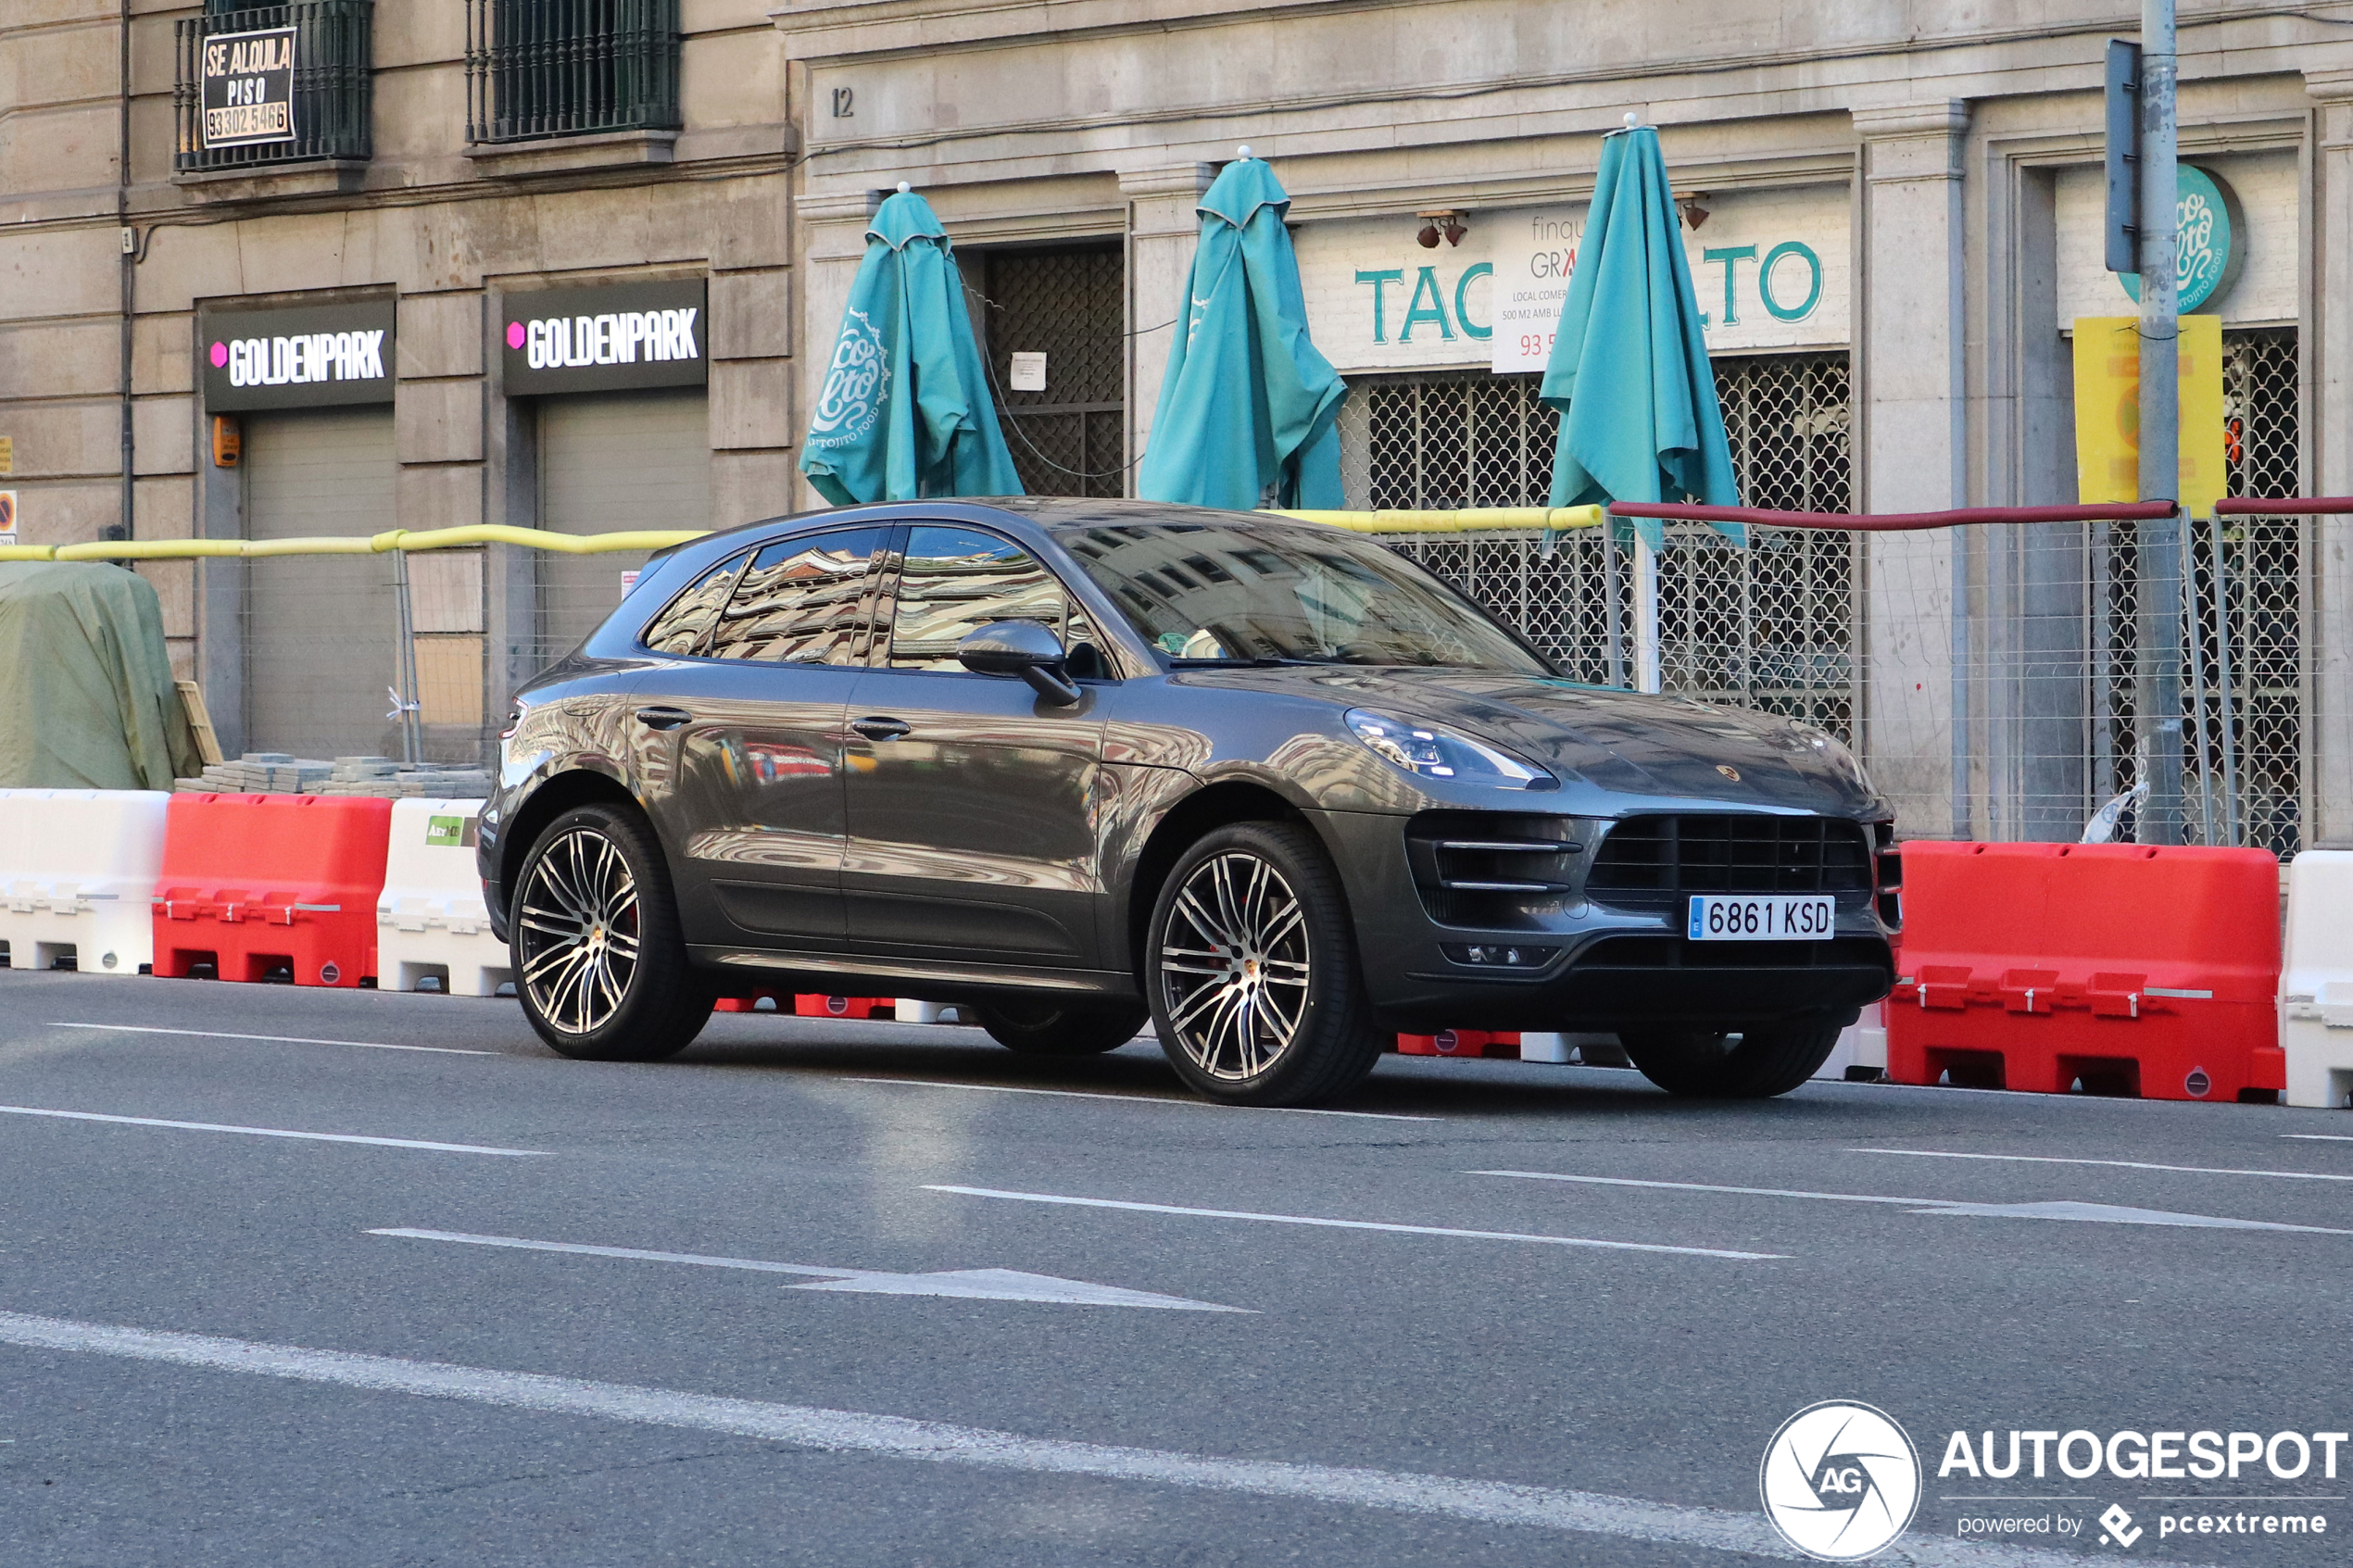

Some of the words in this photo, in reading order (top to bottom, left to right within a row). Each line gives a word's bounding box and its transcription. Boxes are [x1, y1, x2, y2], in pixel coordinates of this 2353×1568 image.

[207, 44, 227, 77] SE
[229, 37, 290, 74] ALQUILA
[227, 77, 266, 107] PISO
[832, 87, 853, 118] 12
[208, 112, 223, 136] 93
[224, 108, 247, 134] 302
[251, 104, 284, 132] 5466
[2207, 247, 2223, 280] FOOD
[1512, 291, 1538, 302] LOCAL
[1538, 289, 1567, 301] COMER
[1699, 241, 1824, 331] TO
[1503, 309, 1517, 320] 500
[1518, 308, 1531, 320] M2
[1532, 307, 1552, 319] AMB
[527, 307, 698, 370] GOLDENPARK
[1520, 333, 1541, 357] 93
[229, 330, 385, 387] GOLDENPARK
[856, 407, 879, 436] FOOD
[1709, 902, 1773, 934] 6861
[1784, 902, 1829, 934] KSD
